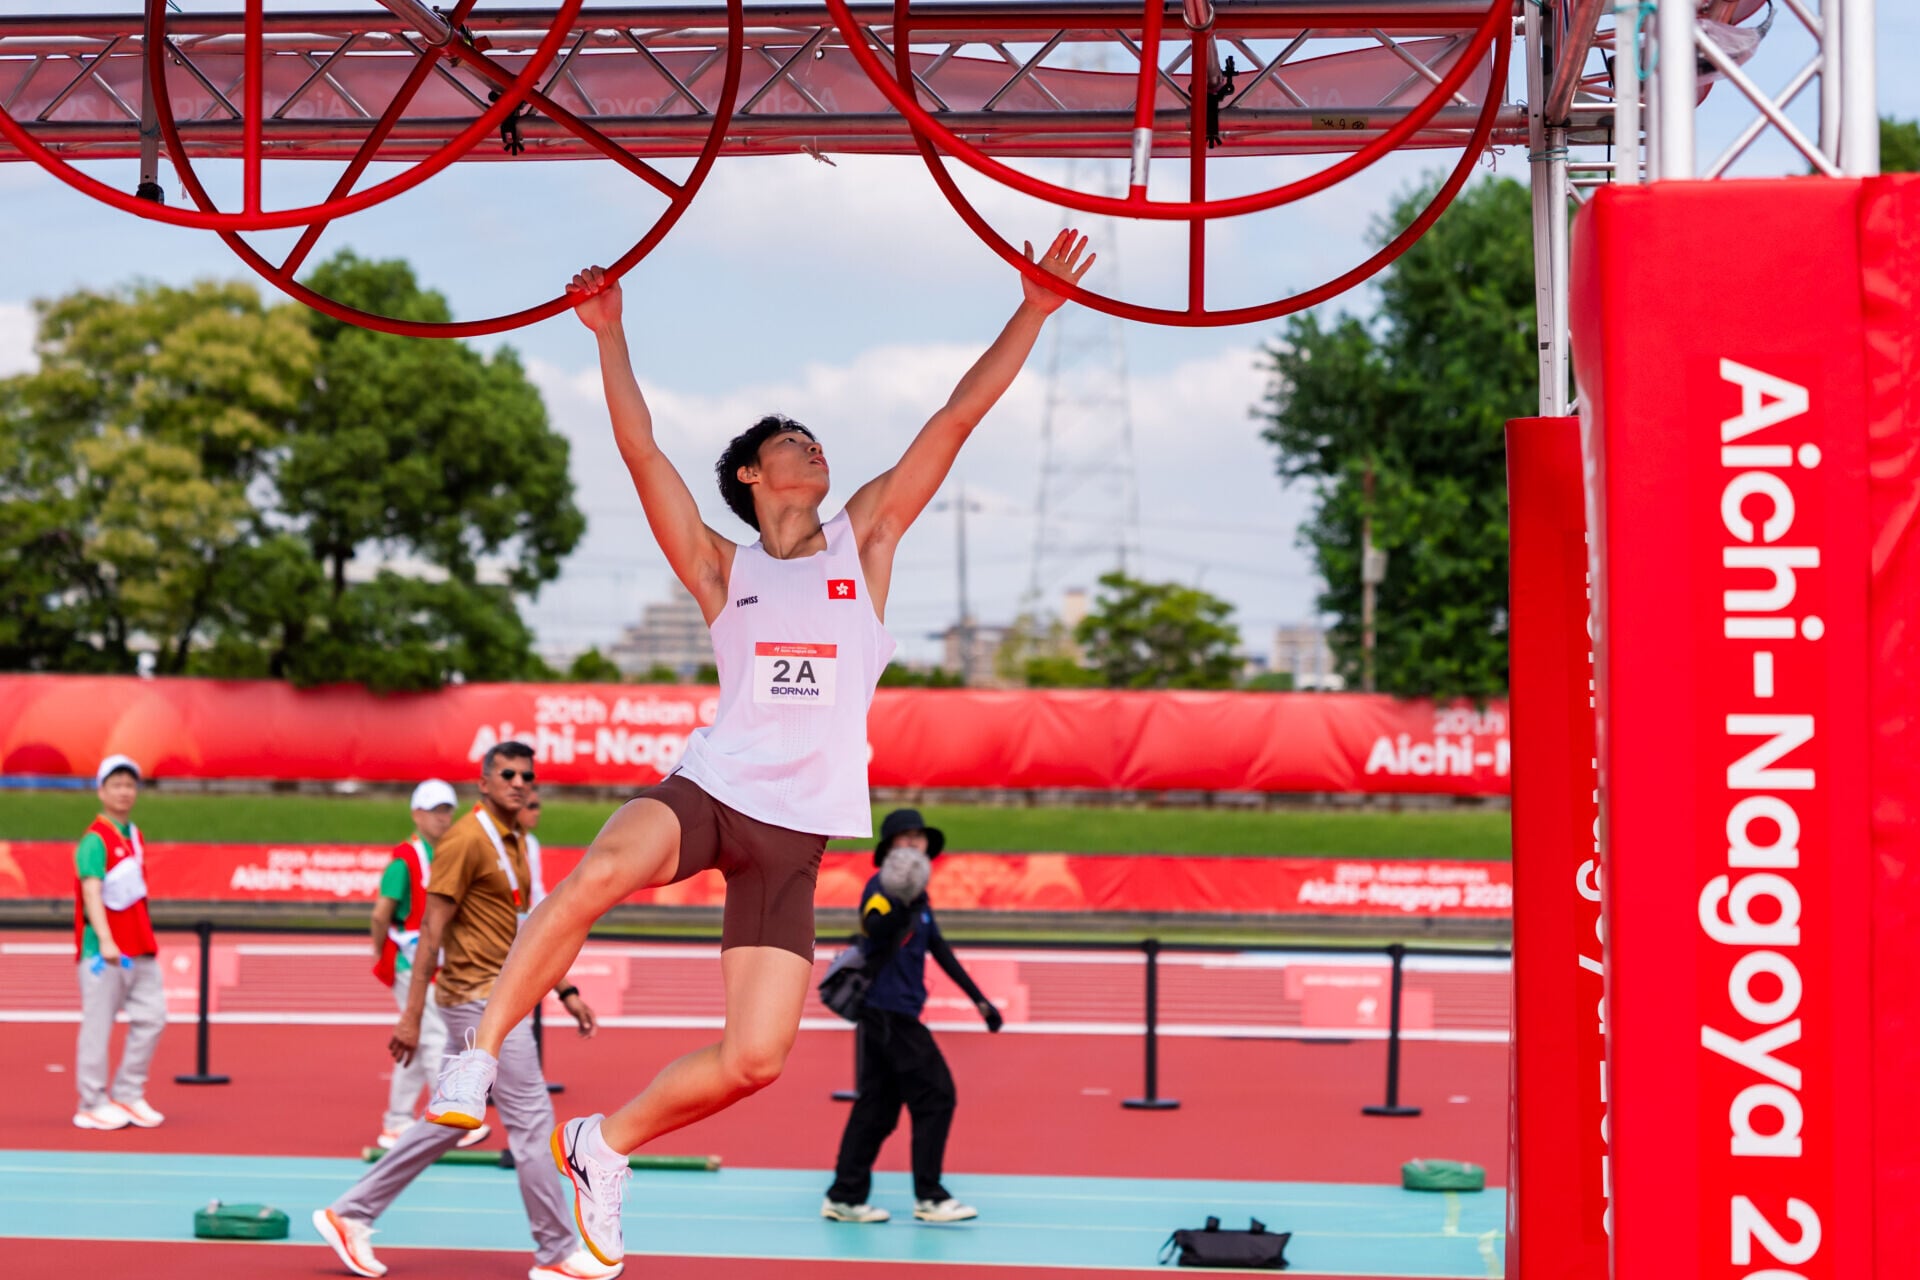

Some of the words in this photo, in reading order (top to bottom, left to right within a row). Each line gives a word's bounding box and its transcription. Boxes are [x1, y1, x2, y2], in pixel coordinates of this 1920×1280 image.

[770, 686, 819, 696] BORNAN
[535, 696, 607, 724] 20th
[611, 697, 695, 725] Asian
[1699, 357, 1825, 1157] Aichi-Nagoya
[230, 864, 382, 896] Aichi-Nagoy
[1731, 1195, 1822, 1280] 2
